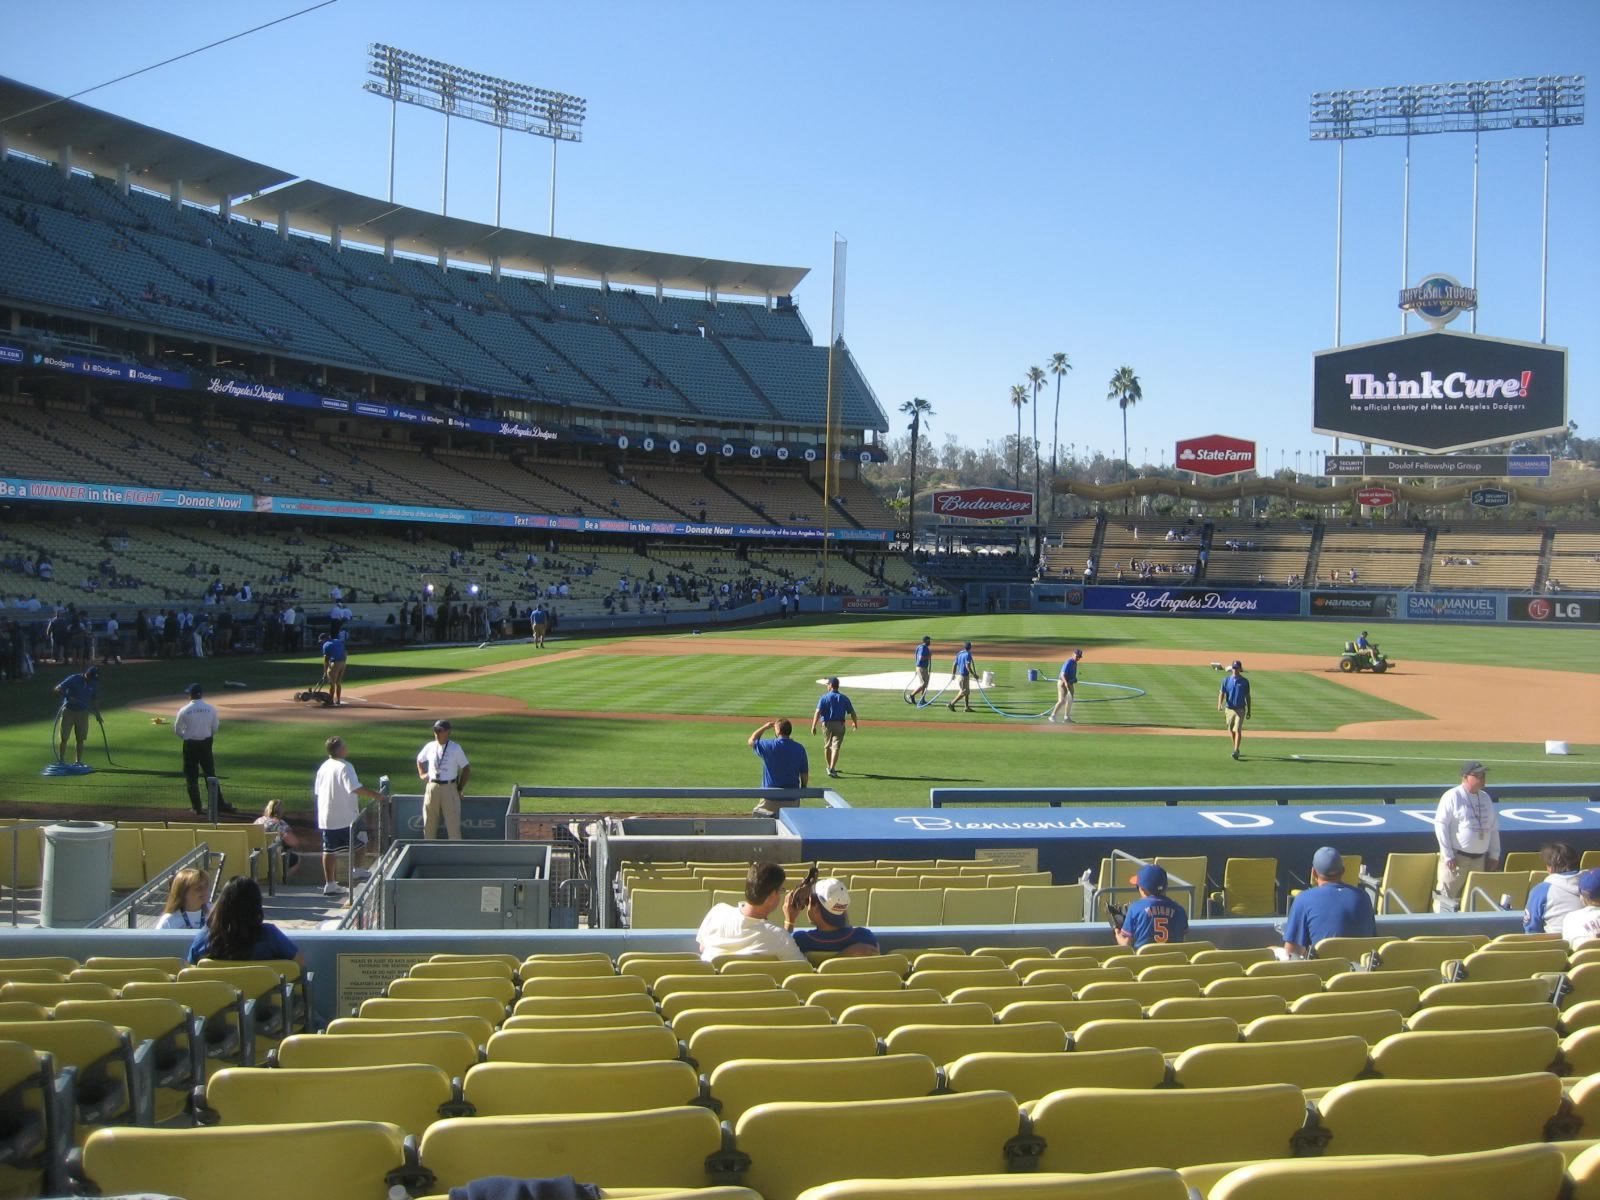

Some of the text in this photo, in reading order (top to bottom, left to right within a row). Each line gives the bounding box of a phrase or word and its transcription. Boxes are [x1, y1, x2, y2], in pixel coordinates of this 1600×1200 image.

[1399, 285, 1478, 302] UNIVERSAL STUDIOS
[207, 378, 285, 402] Los Angeles Dodgers
[1345, 371, 1532, 399] ThinkCure!
[1392, 403, 1419, 412] charity
[1420, 402, 1429, 411] of
[1430, 402, 1442, 410] the
[1444, 402, 1457, 410] Los
[1459, 403, 1490, 412] Angeles
[1492, 402, 1525, 411] Dodgers
[1415, 461, 1455, 471] Fellowship
[1456, 462, 1482, 471] Group
[0, 481, 242, 509] Be a WINNER in the FIGHT Donate Now!
[937, 495, 1031, 511] Budweiser
[514, 515, 529, 526] Text
[585, 520, 594, 529] Be
[629, 523, 637, 531] in
[638, 523, 650, 532] the
[685, 525, 712, 534] Donate
[713, 526, 734, 535] Now!
[895, 532, 911, 540] 4:50
[1126, 591, 1257, 614] Los Angeles Dodgers
[1409, 597, 1494, 610] SAN MANUEL
[1555, 603, 1581, 618] LG
[893, 816, 1126, 831] Bienvenidos
[1153, 917, 1169, 944] 5
